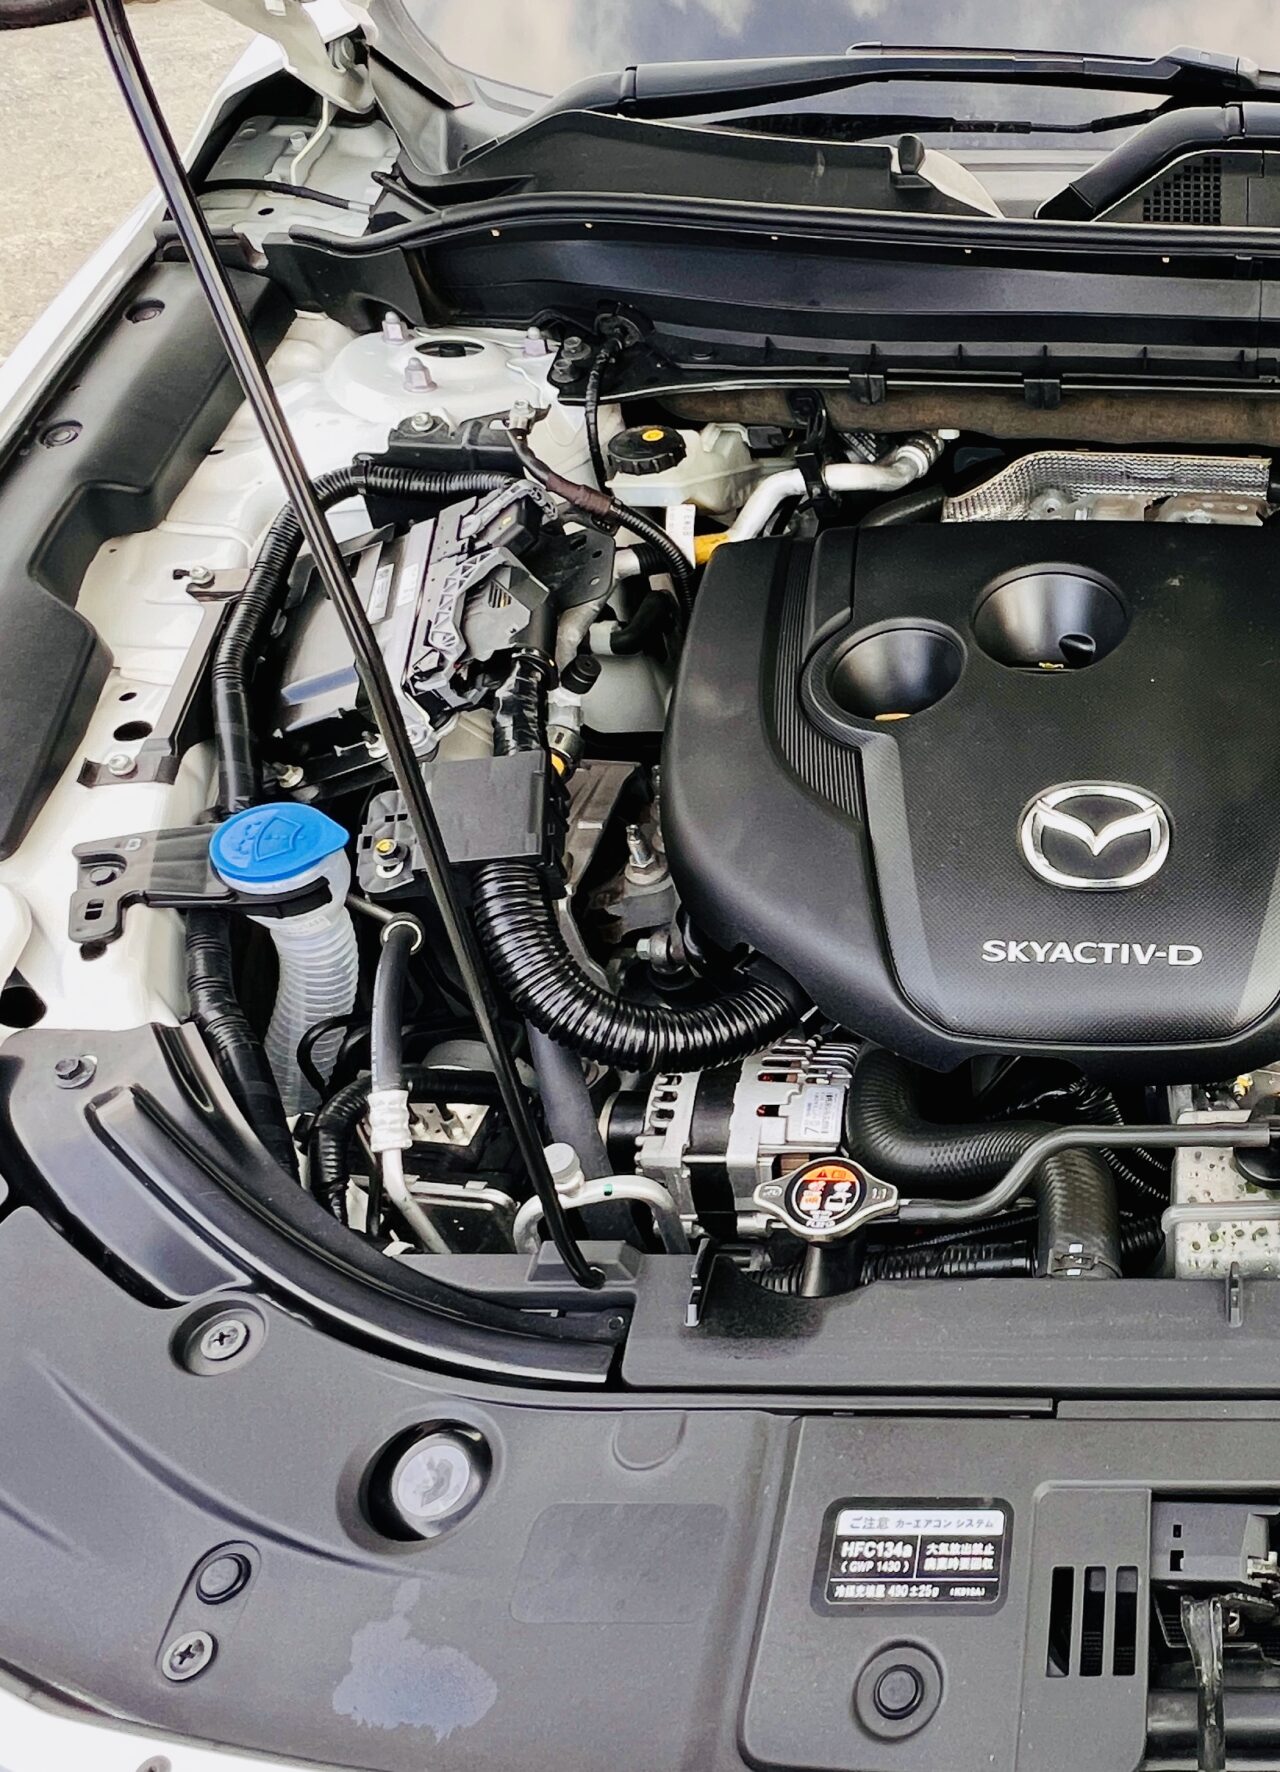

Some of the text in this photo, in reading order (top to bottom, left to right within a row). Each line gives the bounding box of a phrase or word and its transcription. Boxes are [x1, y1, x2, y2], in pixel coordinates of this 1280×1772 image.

[981, 939, 1203, 967] SKYACTIV-D
[850, 1516, 995, 1530] ご注意 カーエアコン システム
[840, 1541, 914, 1559] HFC134a
